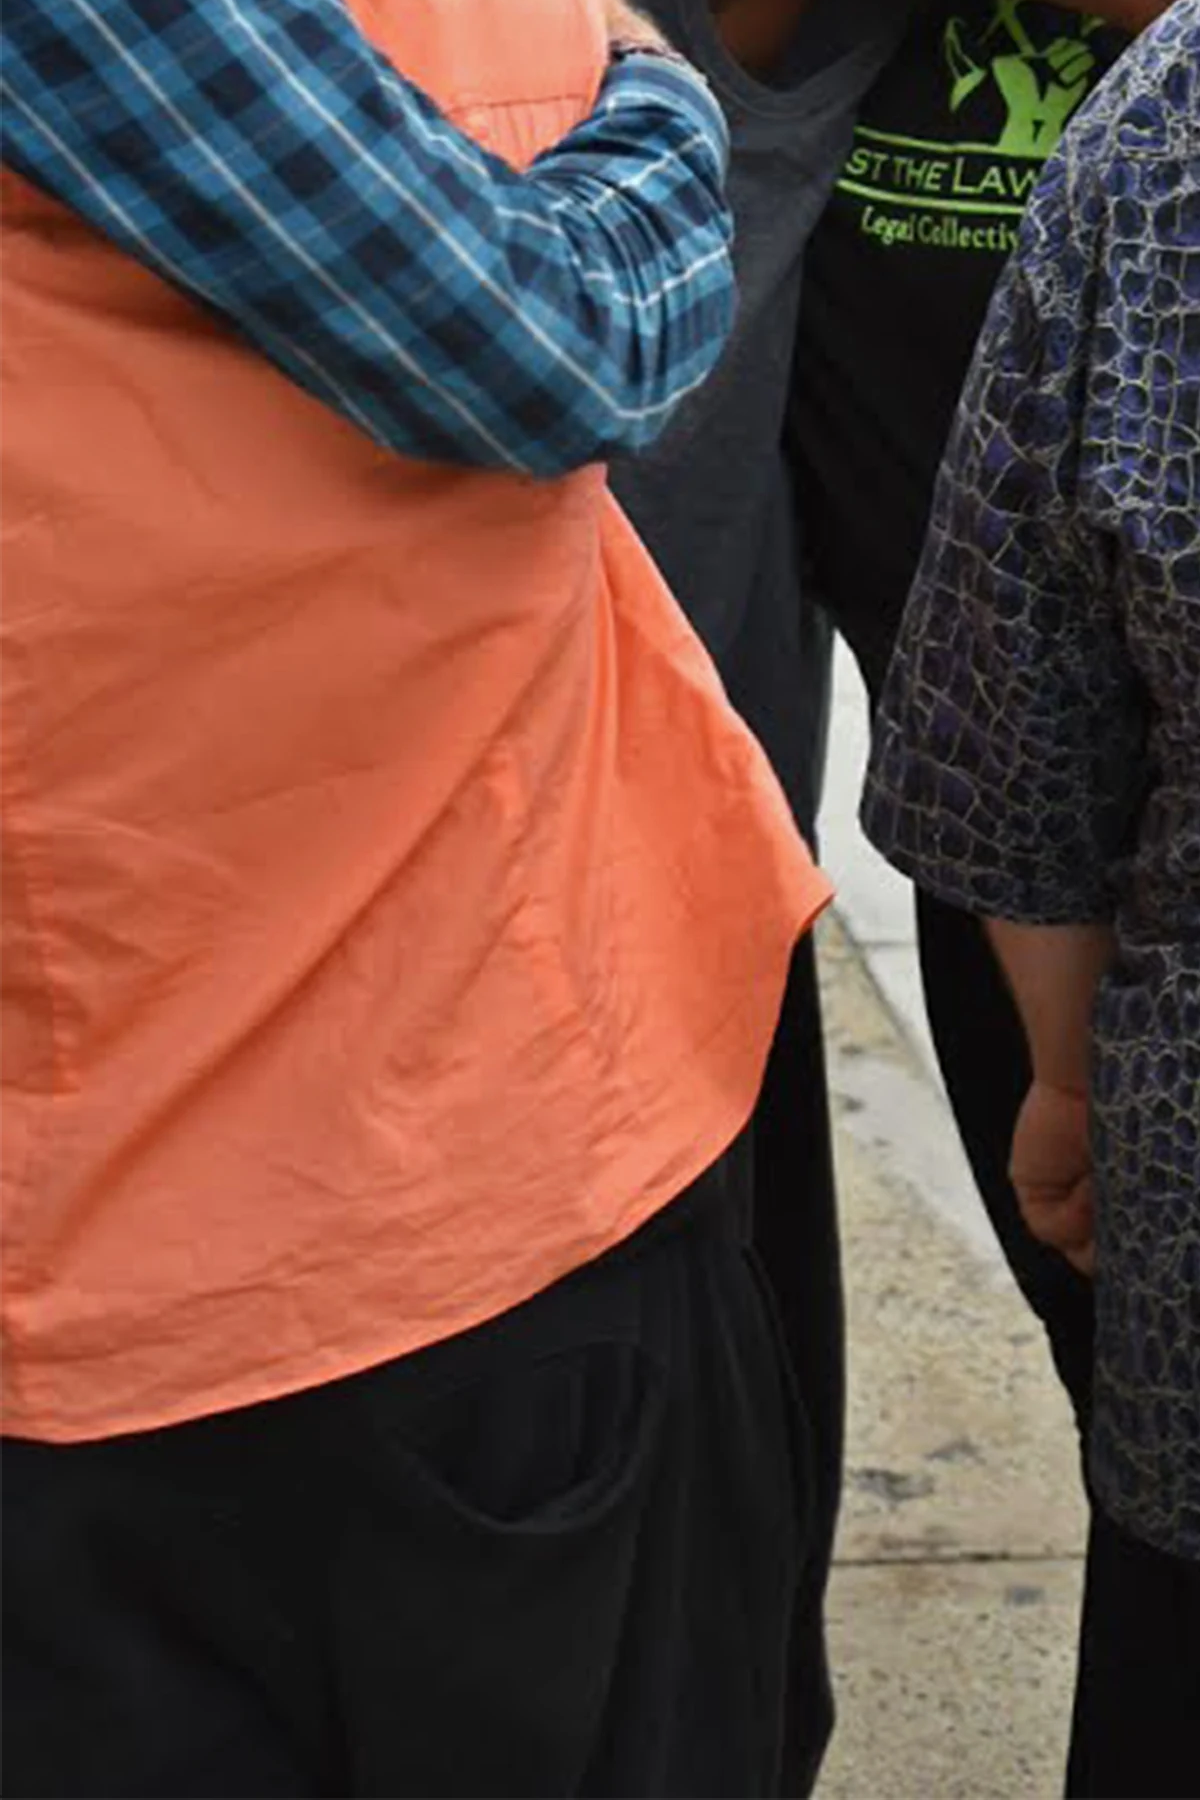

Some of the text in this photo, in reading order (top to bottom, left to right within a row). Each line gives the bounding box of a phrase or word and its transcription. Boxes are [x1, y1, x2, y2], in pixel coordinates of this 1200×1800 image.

[891, 155, 950, 192] THE
[951, 156, 1040, 198] LAW
[860, 205, 1021, 251] Legal Collectiv
